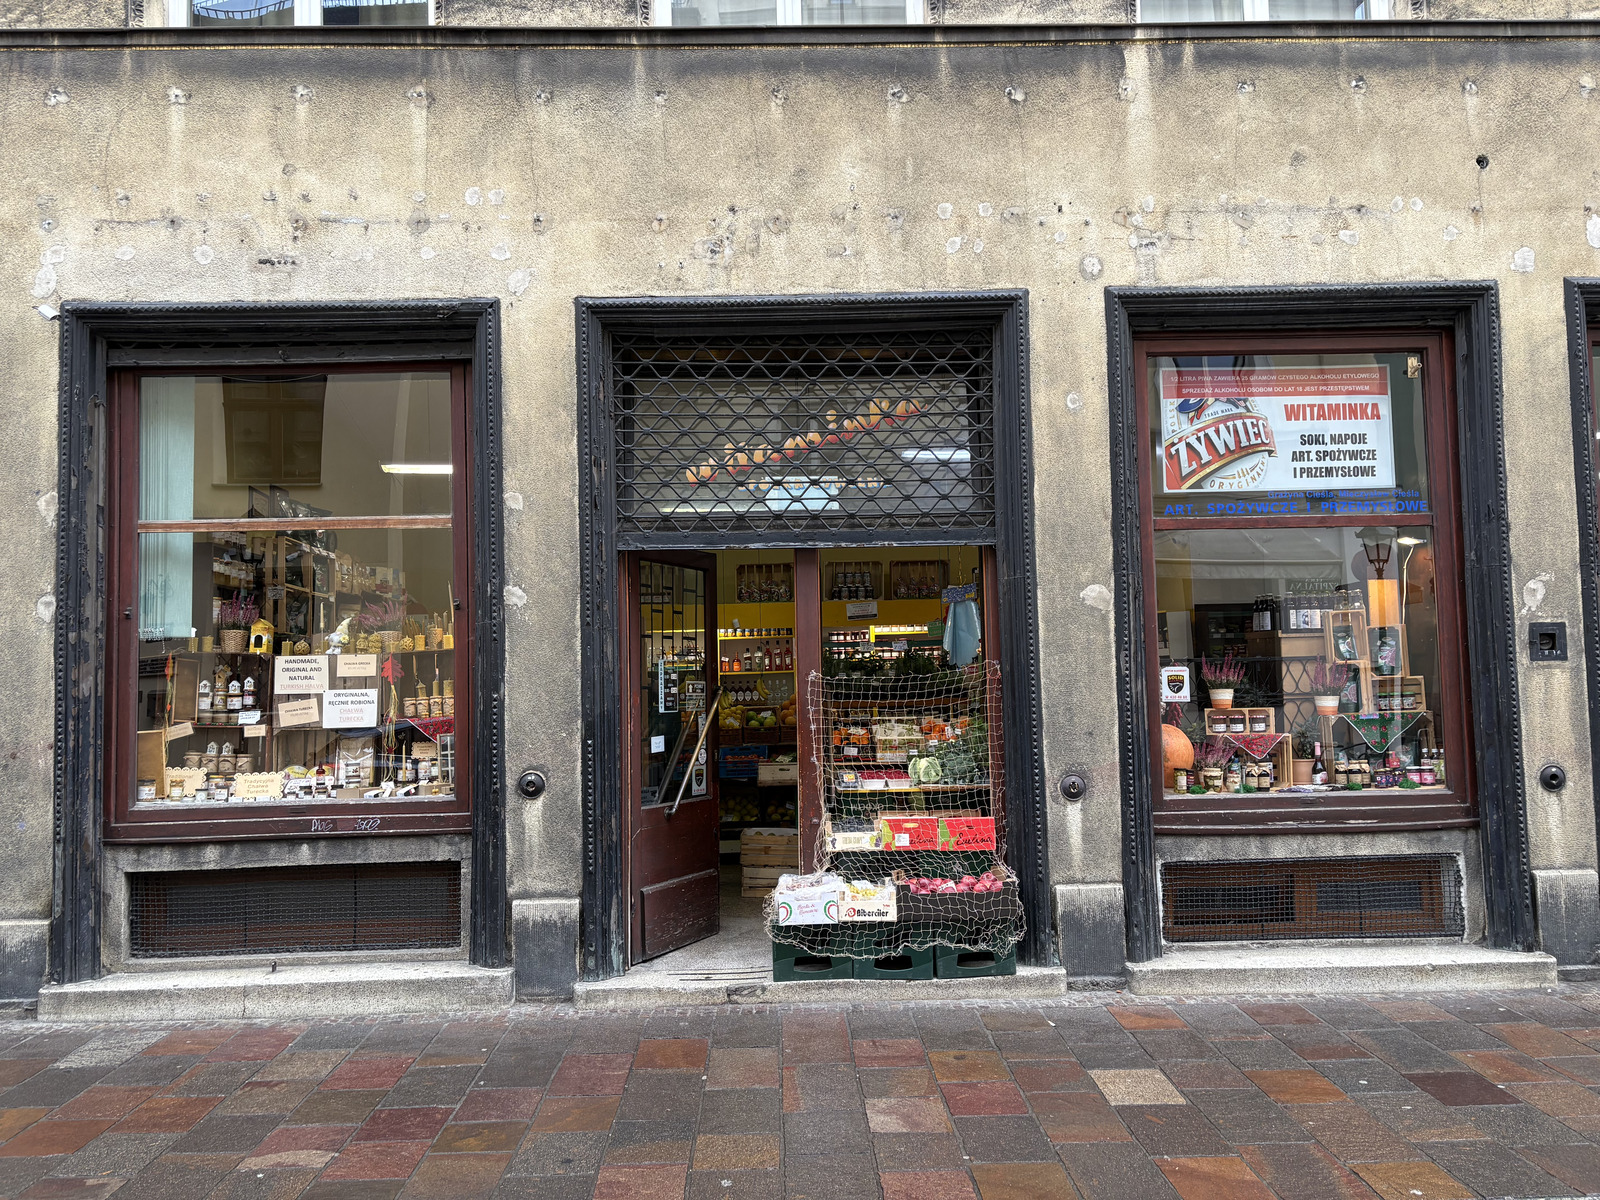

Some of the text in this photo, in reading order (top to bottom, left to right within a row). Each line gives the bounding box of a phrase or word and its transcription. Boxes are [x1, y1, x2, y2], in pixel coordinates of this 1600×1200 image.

[1204, 411, 1220, 419] TRADE
[1284, 403, 1381, 421] WITAMINKA
[1300, 433, 1368, 446] SOKI, NAPOJE
[1170, 418, 1270, 477] ŻYWIEC
[1291, 448, 1377, 462] ART. SPOŻYWCZE
[1293, 466, 1376, 478] I PRZEMYSŁOWE
[1267, 489, 1420, 500] Grażyna Cieśla, Mieczysław Cieśla
[1164, 500, 1428, 515] ART. SPOŻYWCZE I PRZEMYSŁOWE
